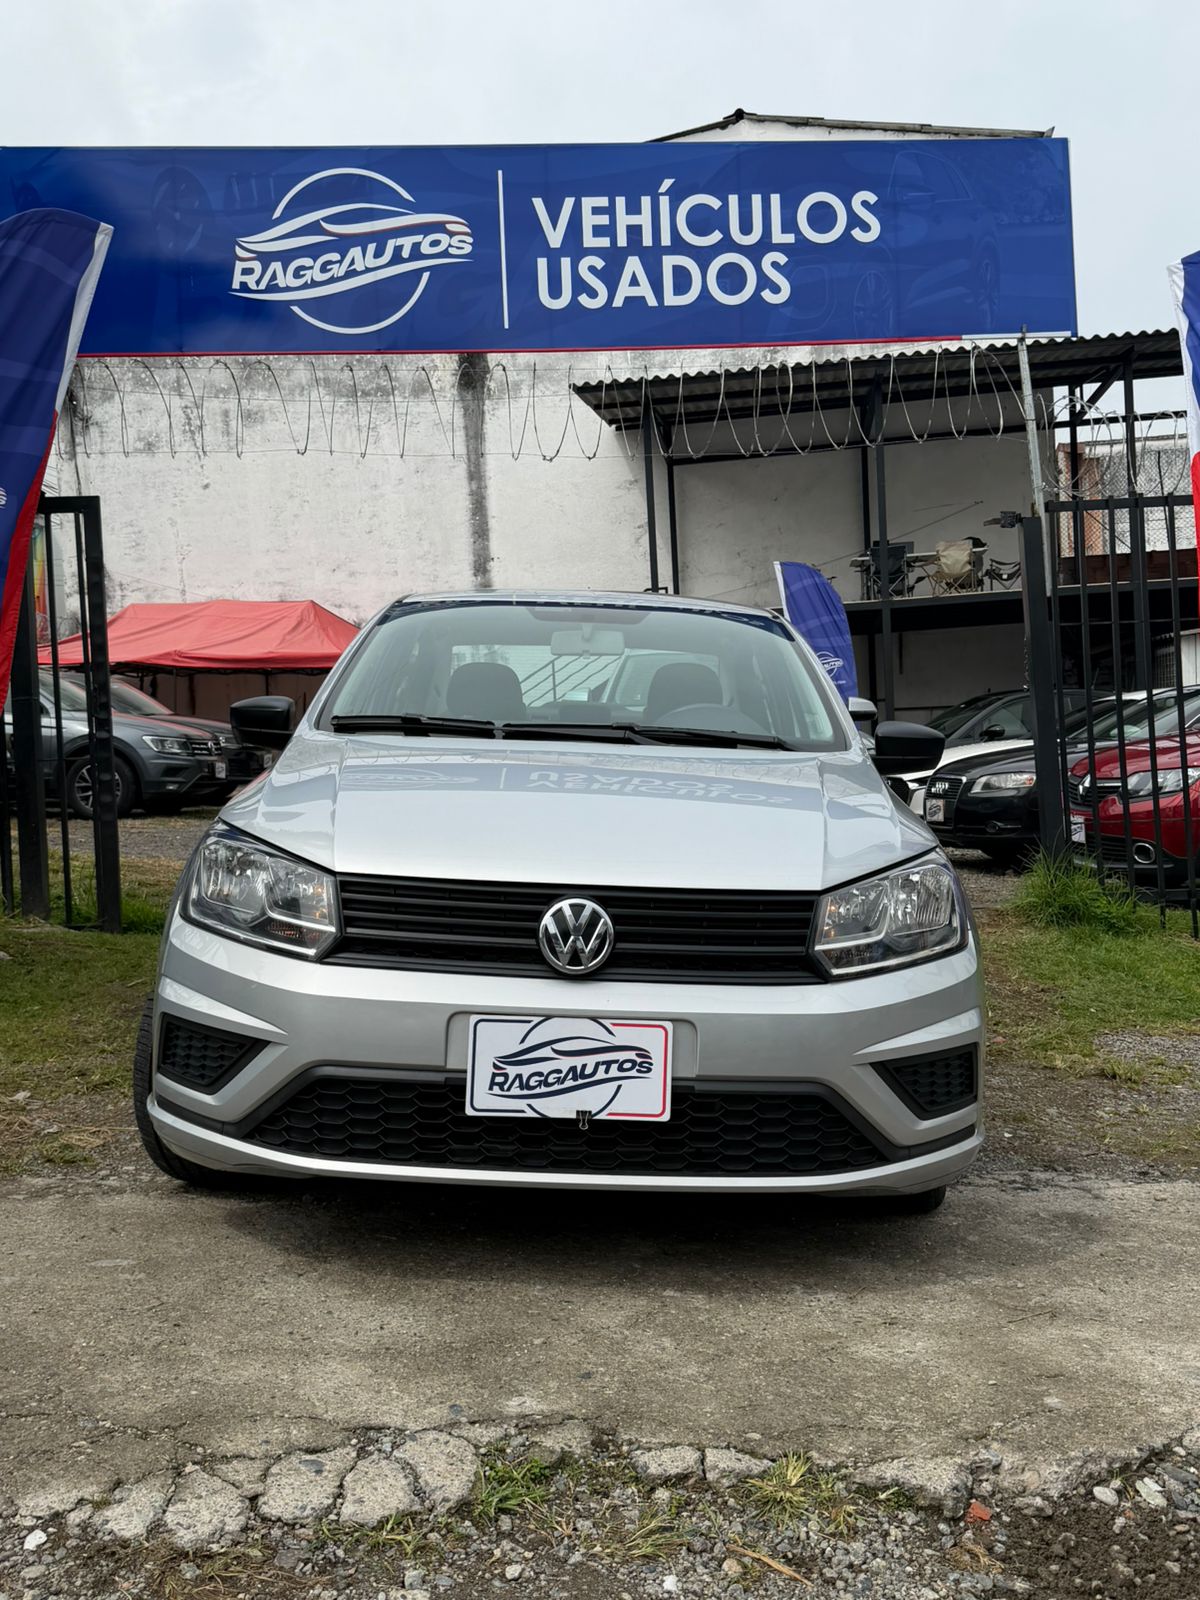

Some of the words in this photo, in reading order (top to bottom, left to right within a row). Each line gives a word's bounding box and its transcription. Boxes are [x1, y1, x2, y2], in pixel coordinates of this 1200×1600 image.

[530, 178, 882, 248] VEHÍCULOS
[231, 233, 474, 290] RAGGAUTOS
[536, 251, 791, 310] USADOS
[487, 1058, 654, 1092] RAGGAUTOS
